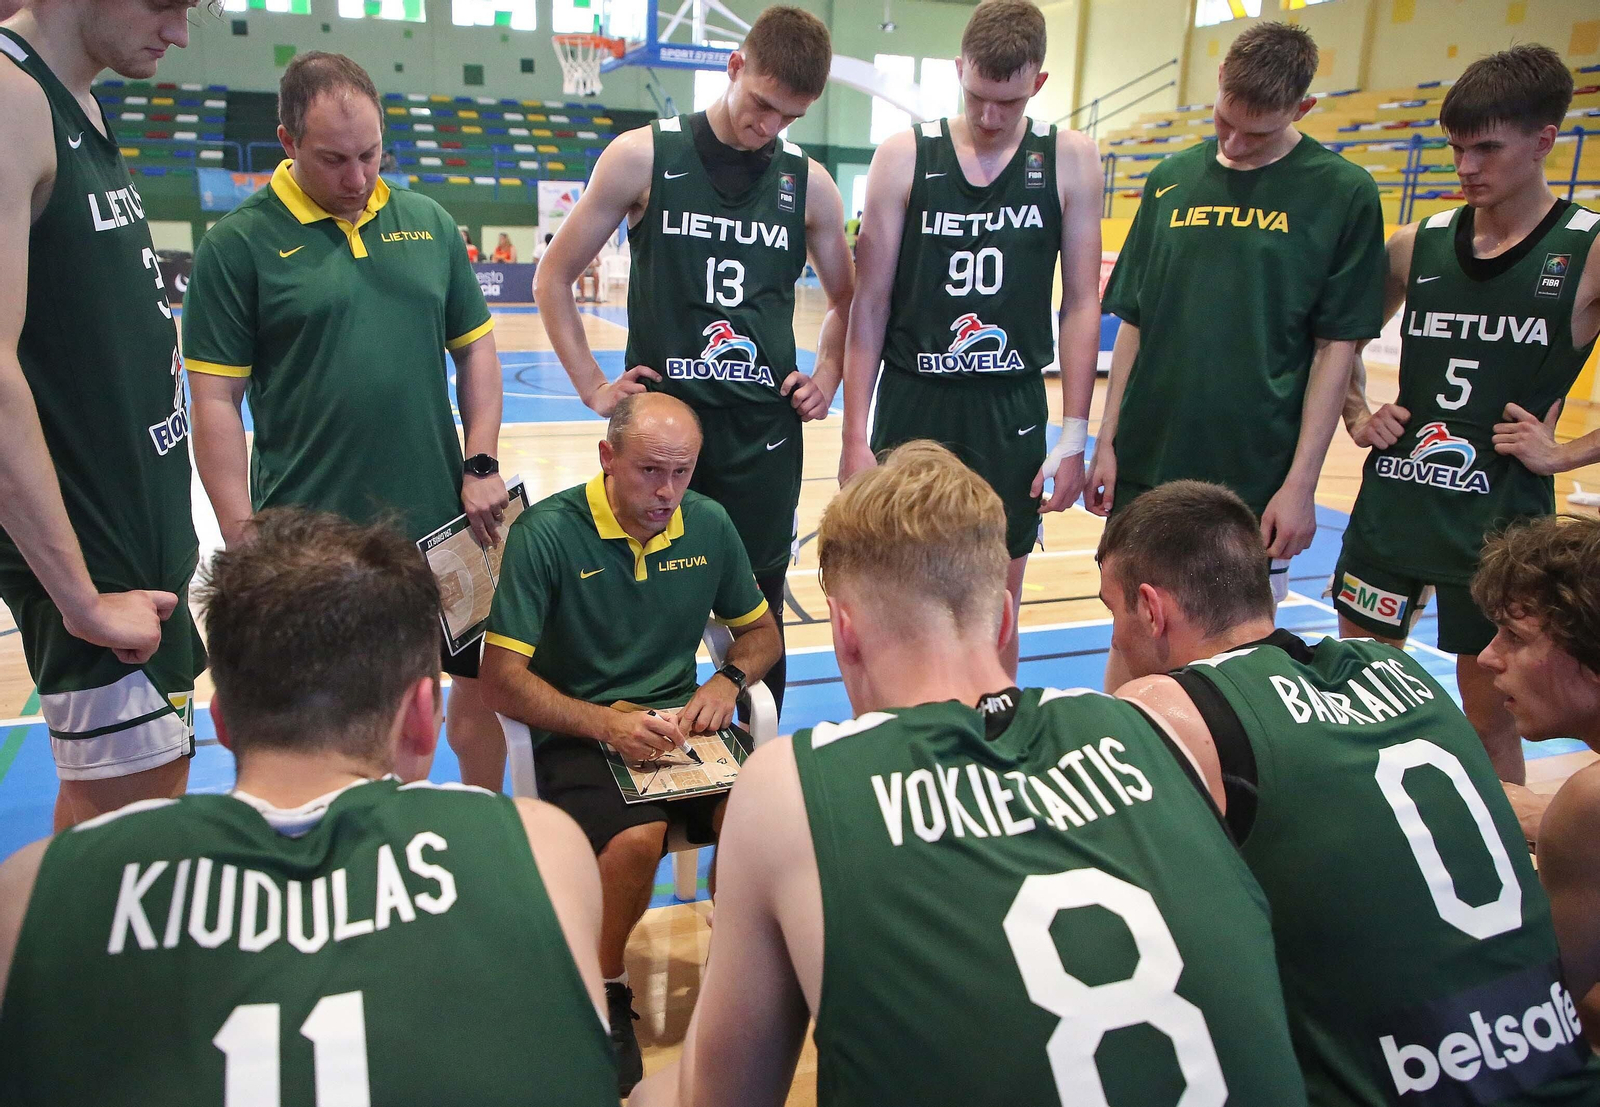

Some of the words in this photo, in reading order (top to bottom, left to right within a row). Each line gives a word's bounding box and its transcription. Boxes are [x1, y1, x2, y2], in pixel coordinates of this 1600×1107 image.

[380, 230, 434, 243] LIETUVA
[662, 205, 790, 251] LIETUVA
[921, 204, 1044, 237] LIETUVA
[1169, 205, 1289, 233] LIETUVA
[706, 257, 746, 308] 13
[945, 247, 1003, 297] 90
[1541, 278, 1560, 287] FIBA
[1408, 310, 1549, 347] LIETUVA
[666, 358, 775, 387] BIOVELA
[917, 349, 1025, 373] BIOVELA
[1435, 358, 1480, 411] 5
[1375, 456, 1490, 494] BIOVELA
[658, 556, 708, 572] LIETUVA
[870, 736, 1153, 846] VOKIETAITIS
[1374, 737, 1523, 941] 0
[108, 831, 458, 954] KIUDULAS
[1002, 867, 1228, 1107] 8
[213, 990, 370, 1107] 11
[1379, 981, 1582, 1096] betsafe
